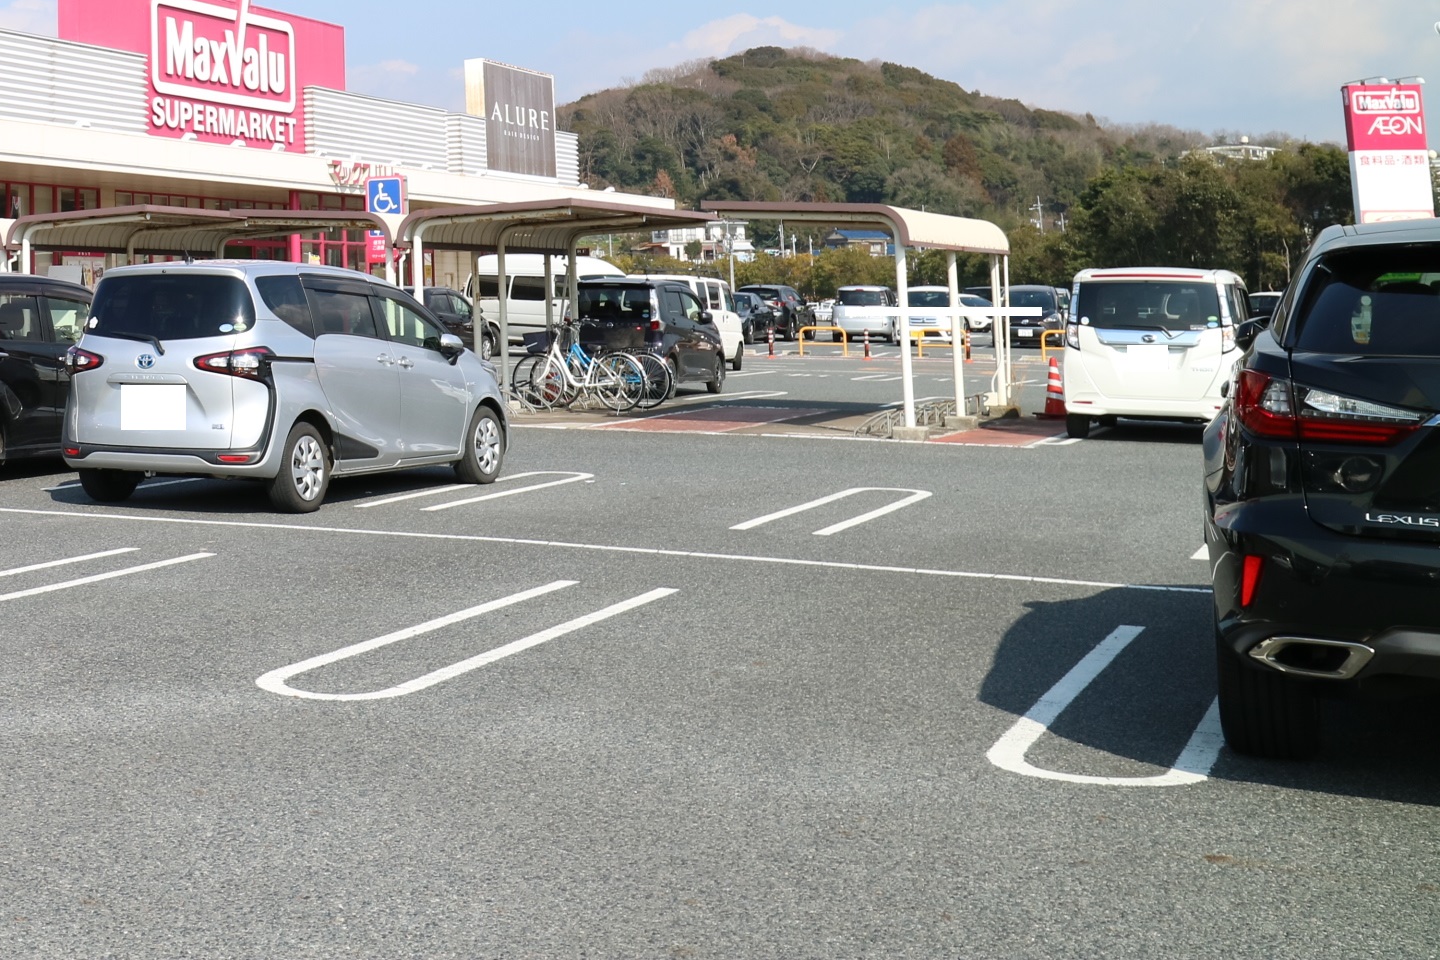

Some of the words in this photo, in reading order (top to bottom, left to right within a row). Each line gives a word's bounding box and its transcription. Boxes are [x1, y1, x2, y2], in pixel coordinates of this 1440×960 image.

[1358, 88, 1415, 111] MaxValu
[151, 97, 297, 143] SUPERMARKET
[491, 101, 550, 131] ALURE
[1365, 512, 1440, 527] LEXUS
